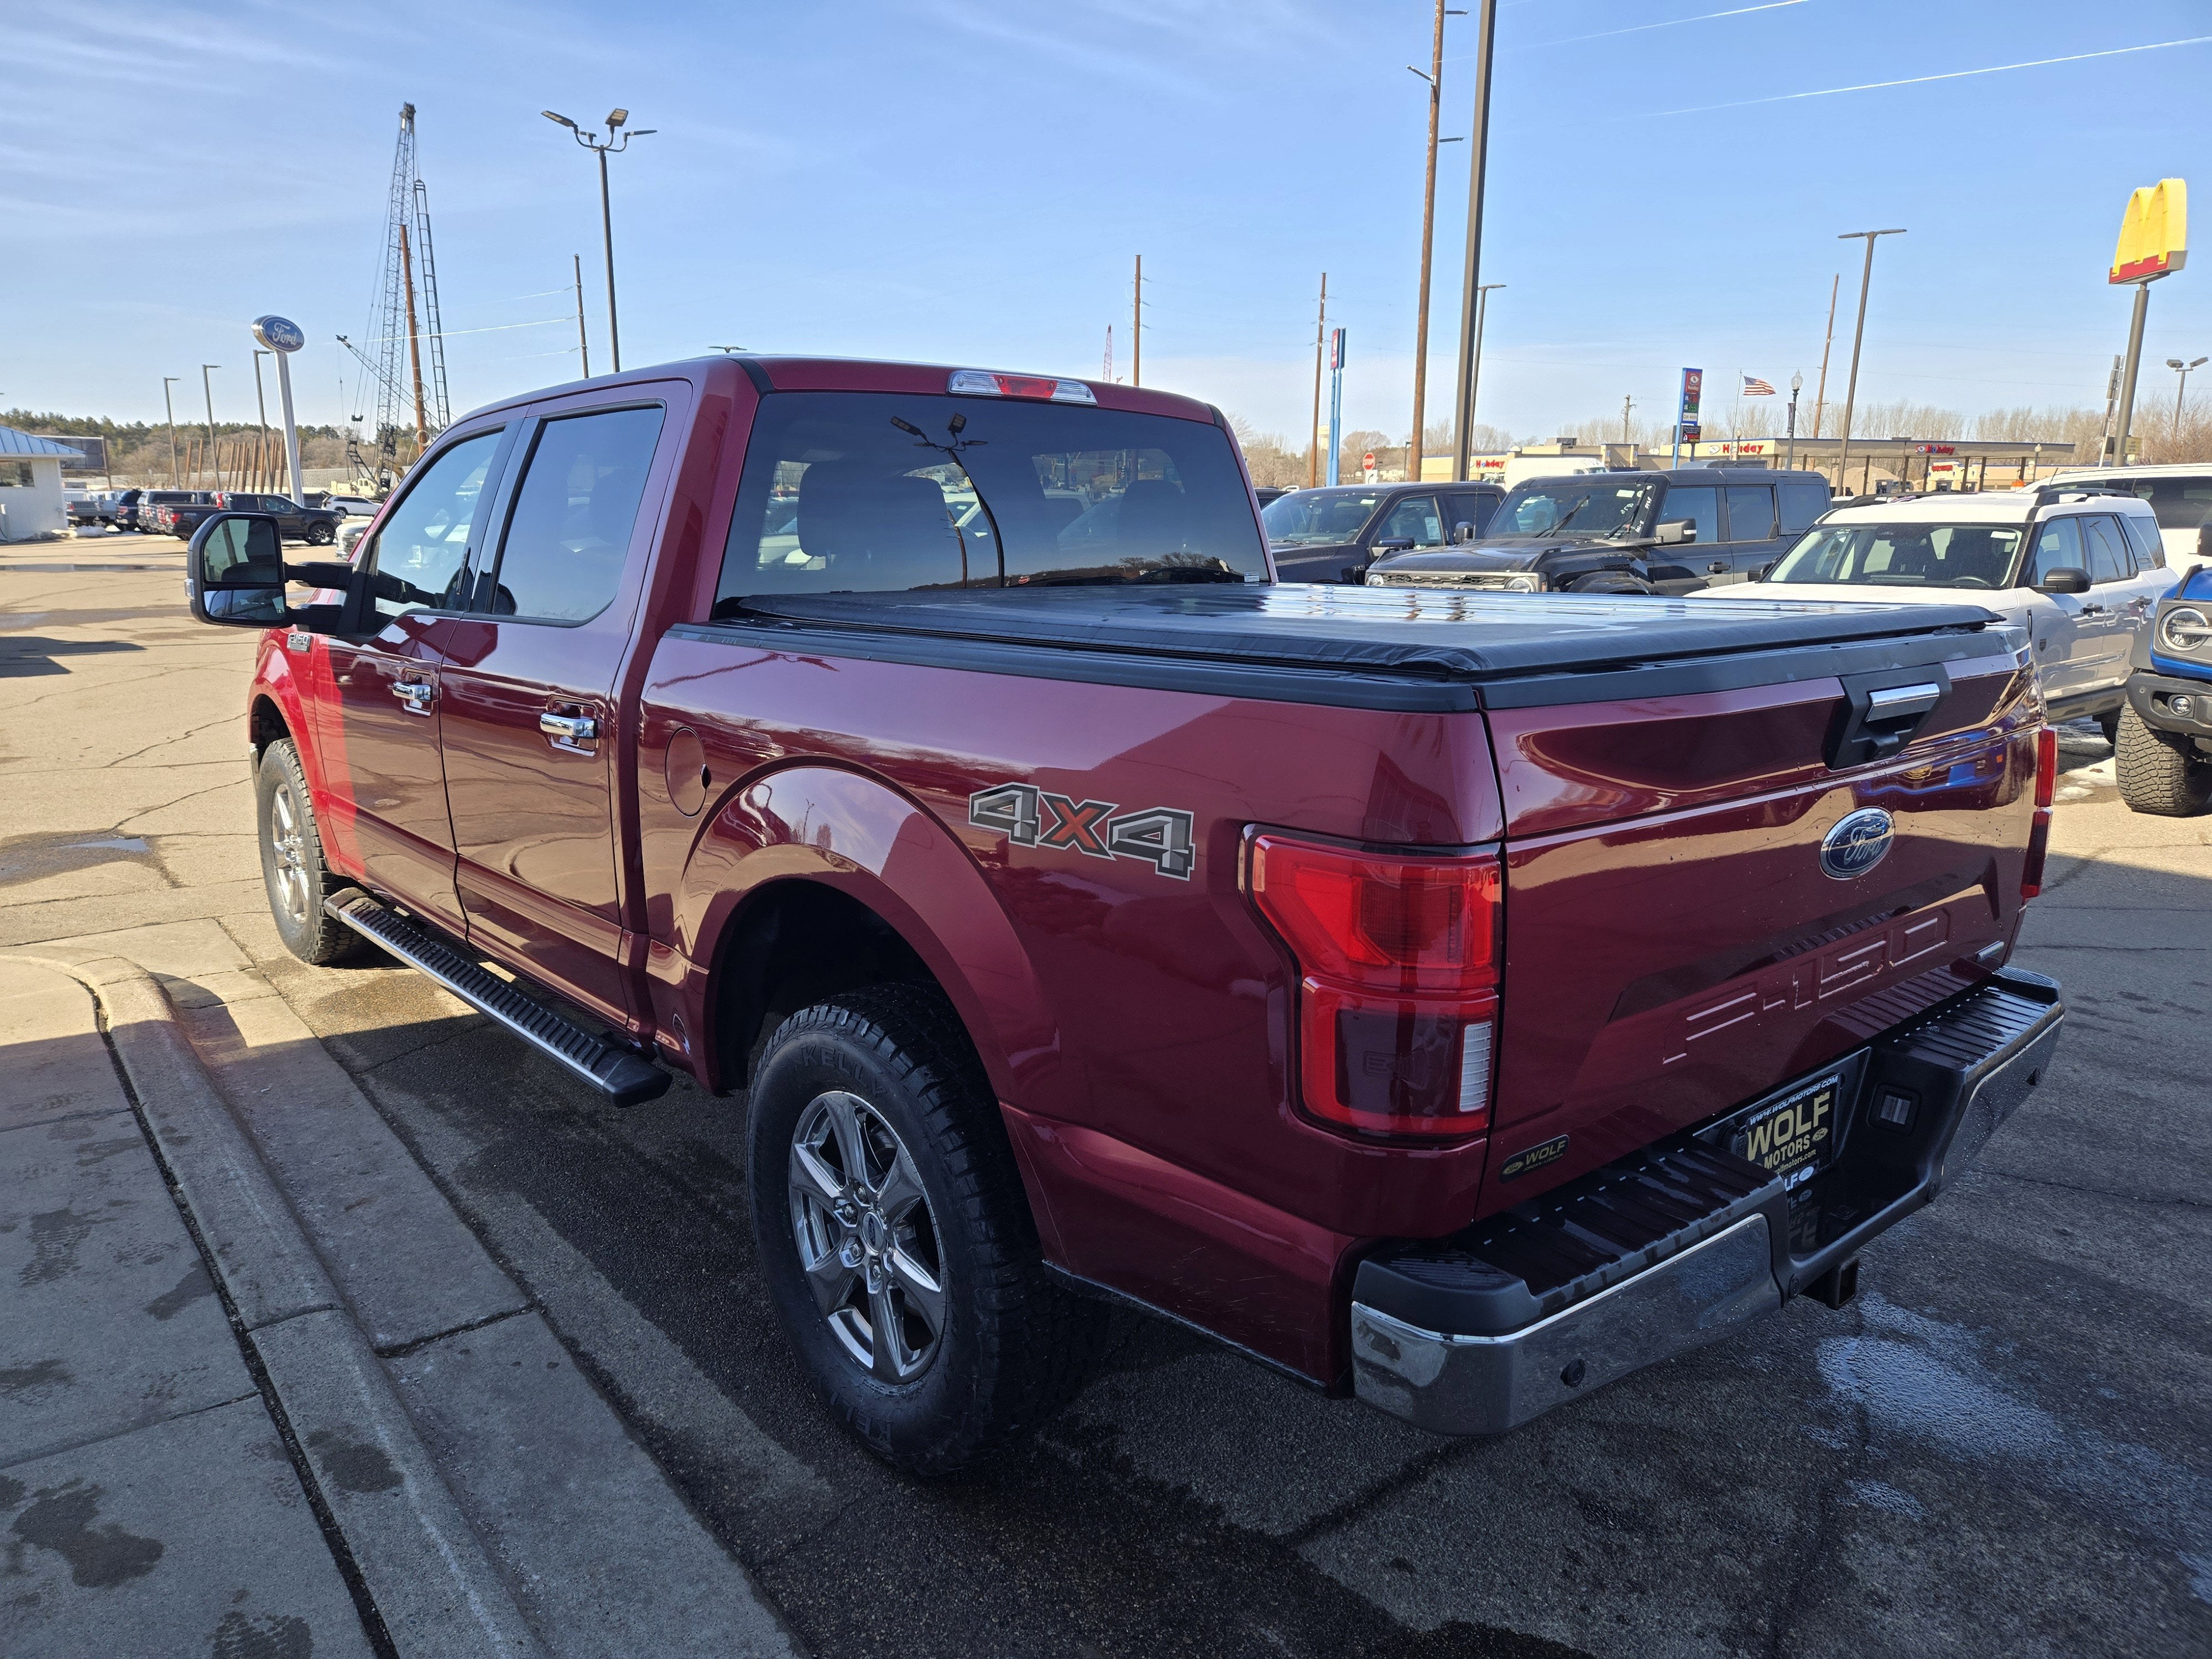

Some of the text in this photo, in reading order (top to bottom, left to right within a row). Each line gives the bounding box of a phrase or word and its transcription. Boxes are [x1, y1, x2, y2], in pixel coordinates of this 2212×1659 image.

[272, 322, 297, 346] Ford
[1723, 443, 1764, 455] Hiday
[1843, 826, 1882, 865] Ford
[1662, 906, 1951, 1065] F-150
[801, 1044, 888, 1098] KELLY
[1747, 1091, 1830, 1162] WOLF
[1526, 1140, 1566, 1165] WOLF
[1764, 1134, 1811, 1170] MOTORS
